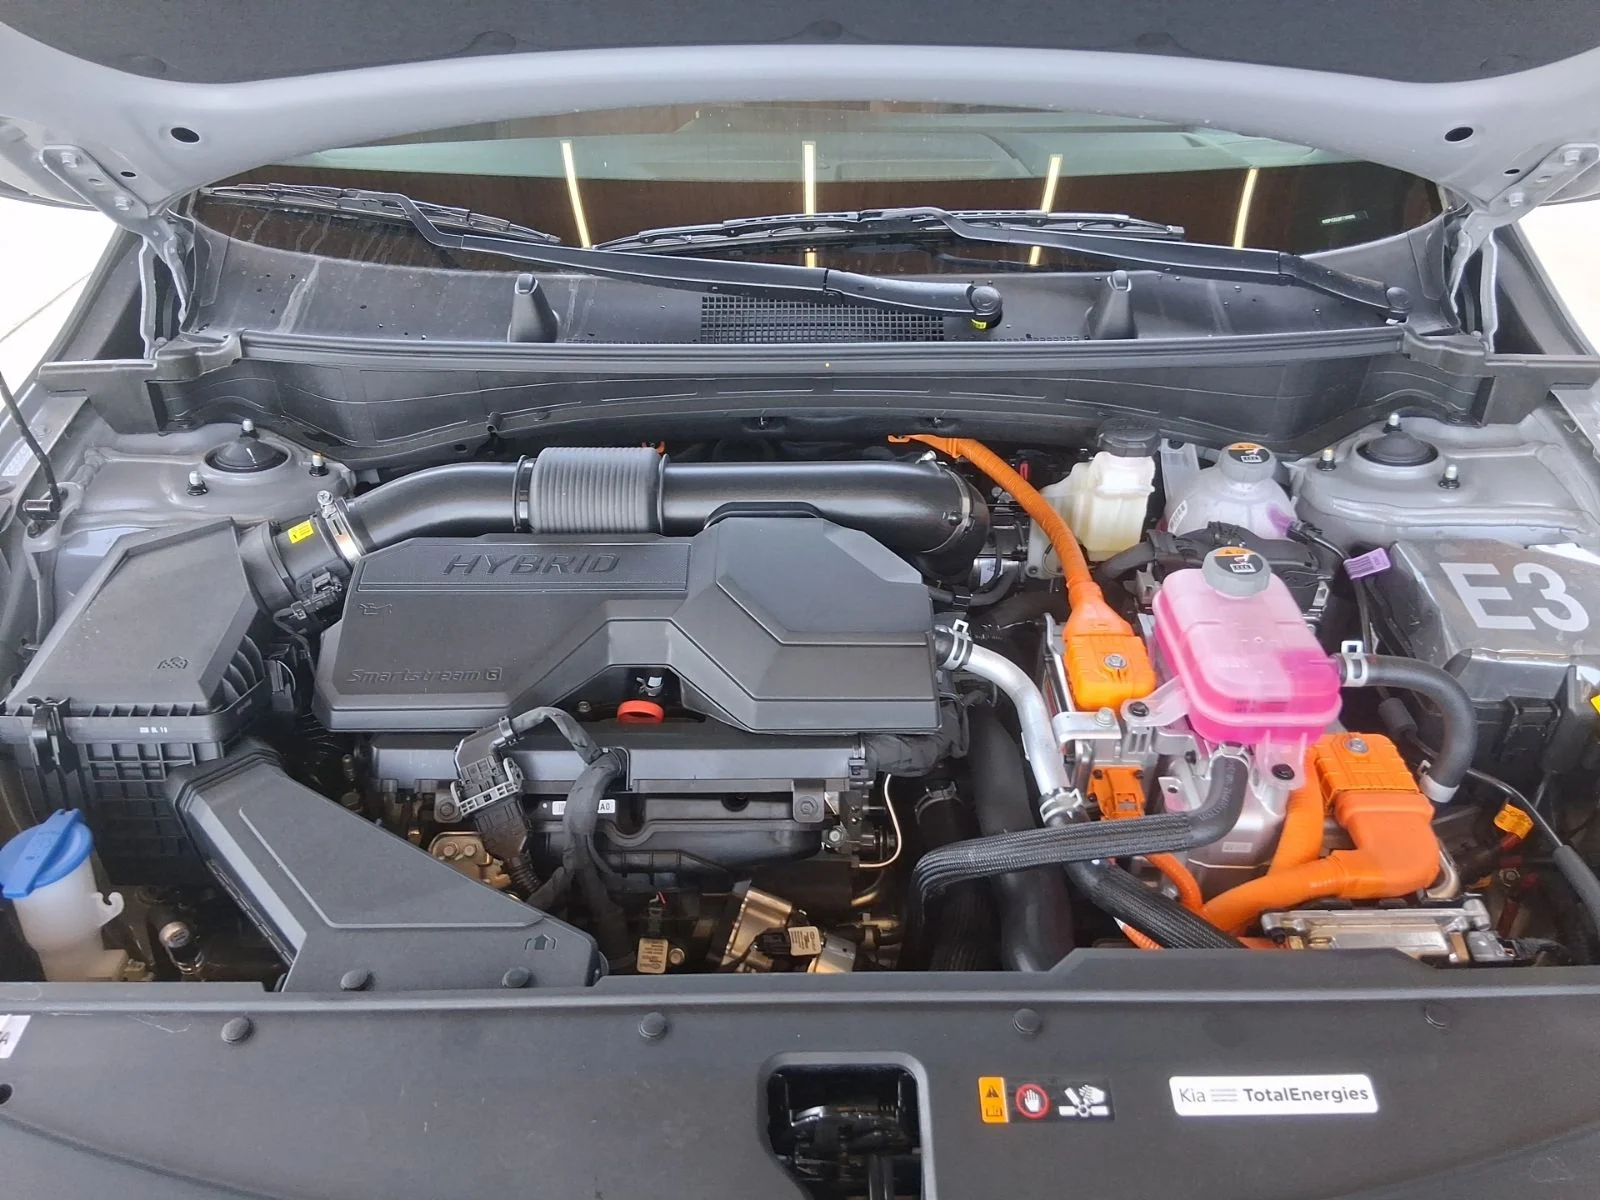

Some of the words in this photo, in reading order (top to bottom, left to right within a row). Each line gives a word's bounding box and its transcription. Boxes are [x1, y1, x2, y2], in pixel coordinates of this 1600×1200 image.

[442, 553, 621, 576] HYBRID
[1439, 562, 1590, 633] E3
[347, 667, 481, 684] Smartstream
[1179, 1087, 1206, 1104] Kia
[1243, 1086, 1370, 1104] TotalEnergies
